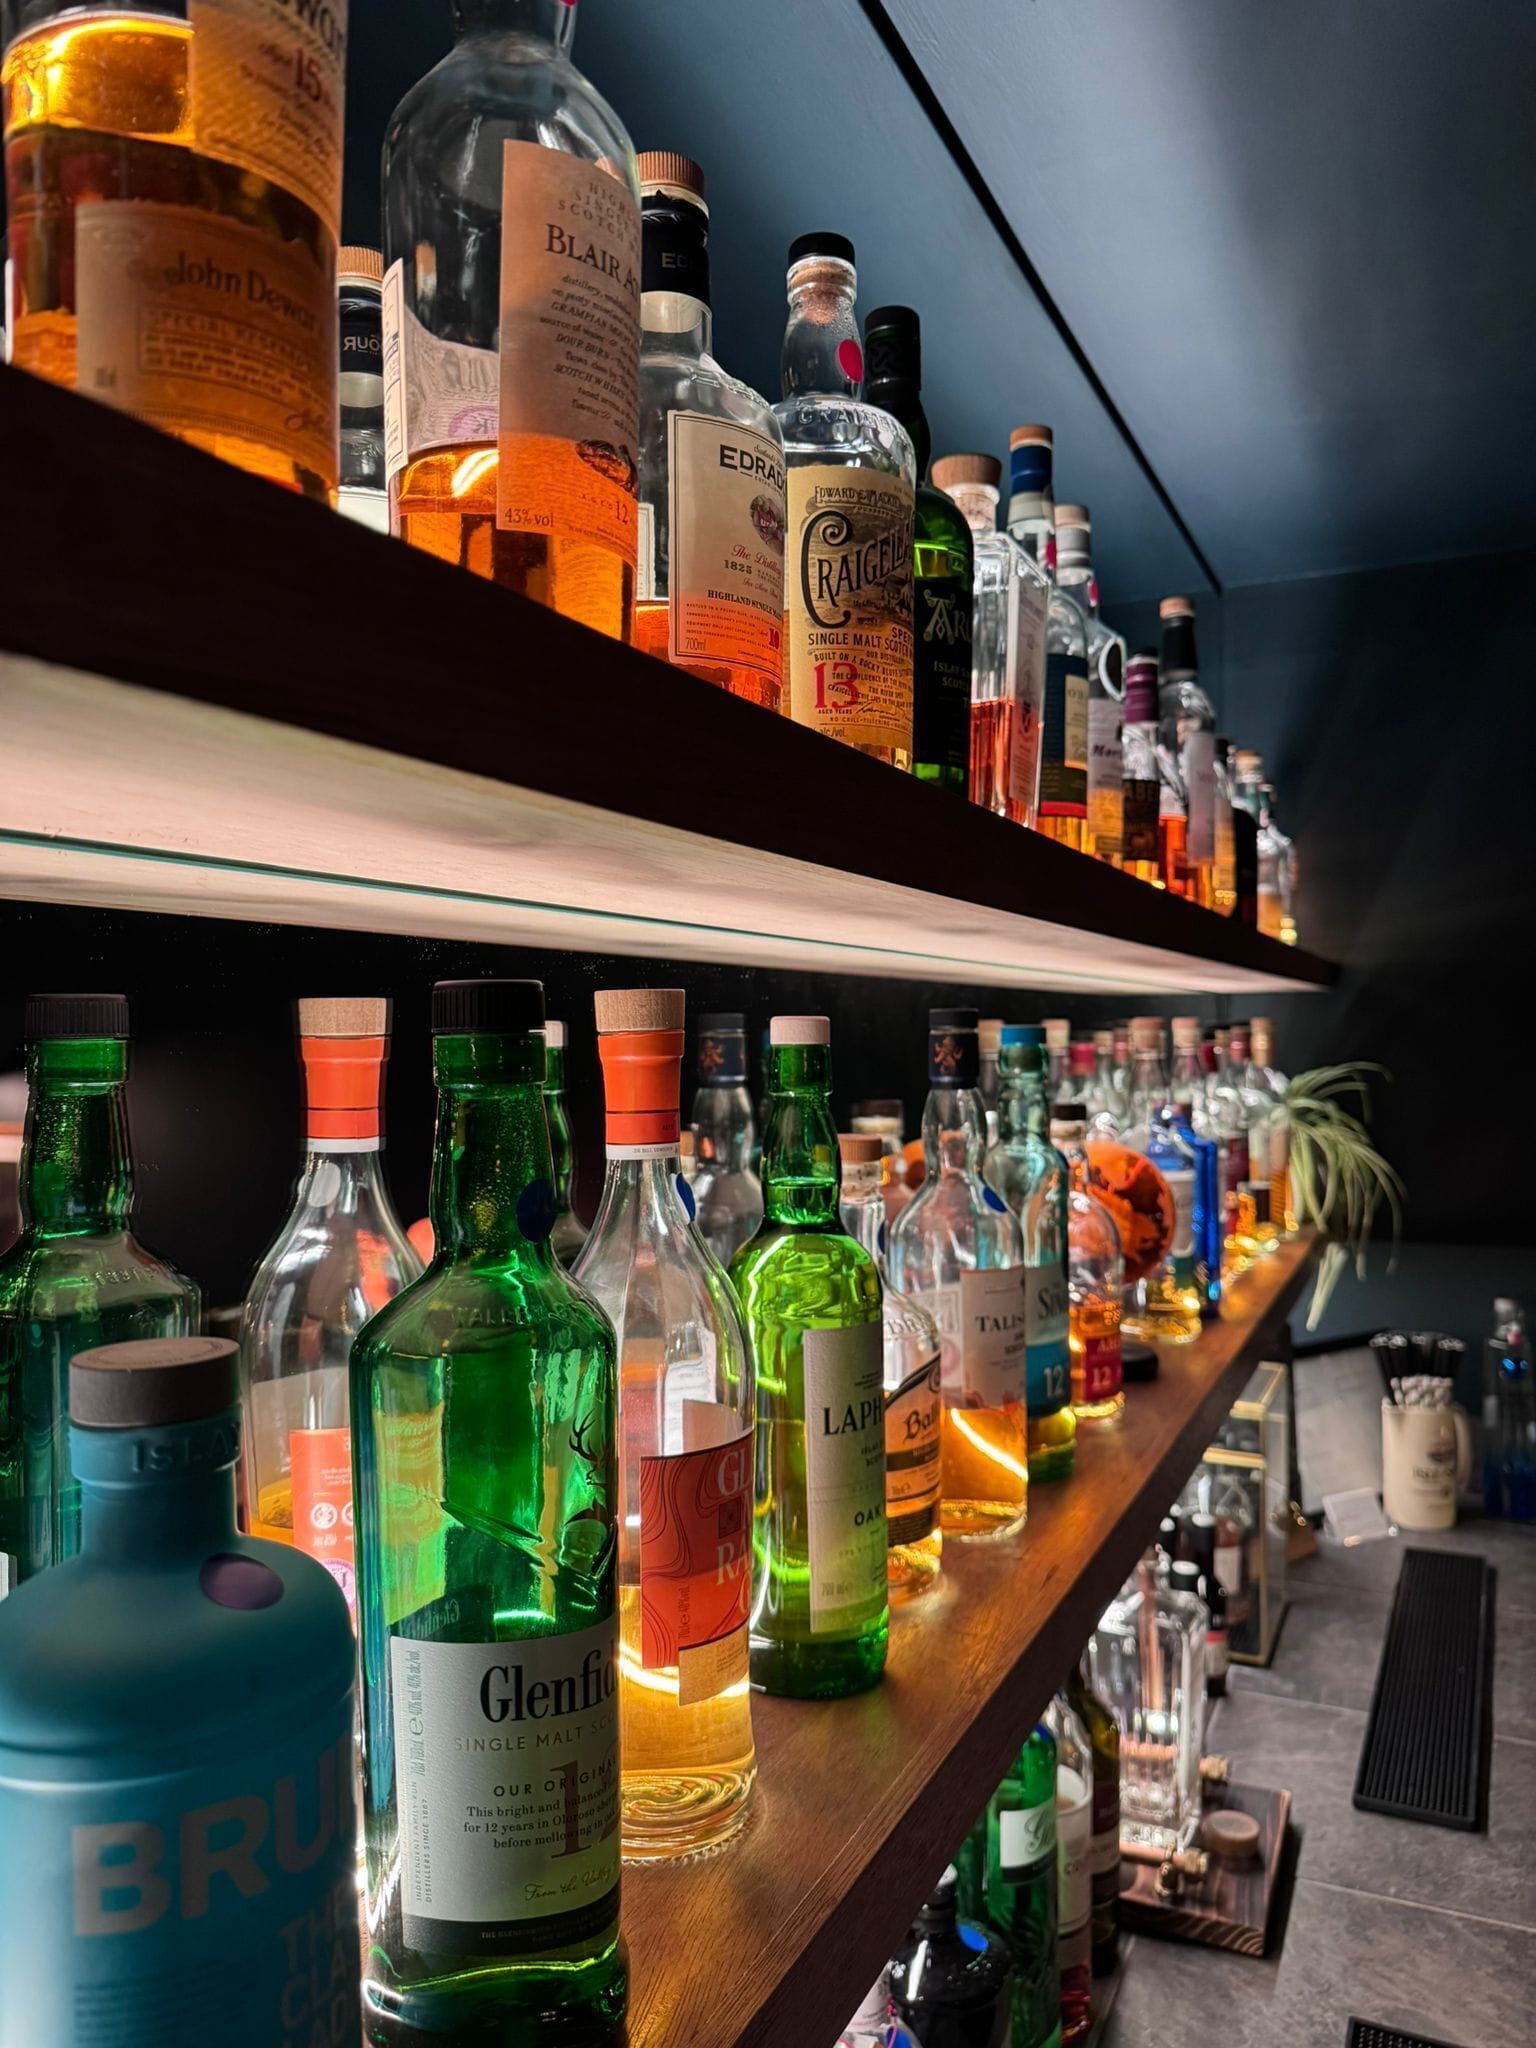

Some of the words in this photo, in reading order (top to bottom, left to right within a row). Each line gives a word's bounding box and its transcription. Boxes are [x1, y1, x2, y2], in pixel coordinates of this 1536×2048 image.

[296, 47, 322, 101] 15
[544, 223, 622, 284] BLAIR
[163, 251, 241, 296] John
[815, 486, 855, 503] EDWARD
[505, 507, 531, 525] 43%
[534, 512, 554, 528] vol
[615, 500, 629, 526] 12
[731, 544, 751, 561] The
[724, 559, 753, 575] 1825
[708, 589, 751, 606] HIGHLAND
[808, 633, 849, 646] SINGLE
[853, 633, 881, 649] MALT
[814, 652, 836, 662] BUILT
[839, 652, 849, 661] ON
[814, 661, 859, 709] 13
[1044, 1364, 1064, 1399] 12
[1091, 1365, 1112, 1389] 12
[455, 1736, 527, 1752] SINGLE
[536, 1726, 583, 1748] MALT
[493, 1783, 533, 1797] OUR
[466, 1806, 493, 1817] This
[497, 1803, 535, 1819] bright
[538, 1800, 561, 1812] and
[422, 1823, 431, 1850] SINCE
[463, 1823, 481, 1833] for
[485, 1822, 498, 1833] 12
[501, 1823, 535, 1836] years
[537, 1818, 550, 1829] in
[493, 1838, 532, 1849] before
[535, 1826, 593, 1846] mellowing
[422, 1853, 432, 1903] DISTILLERS
[524, 1883, 557, 1902] From
